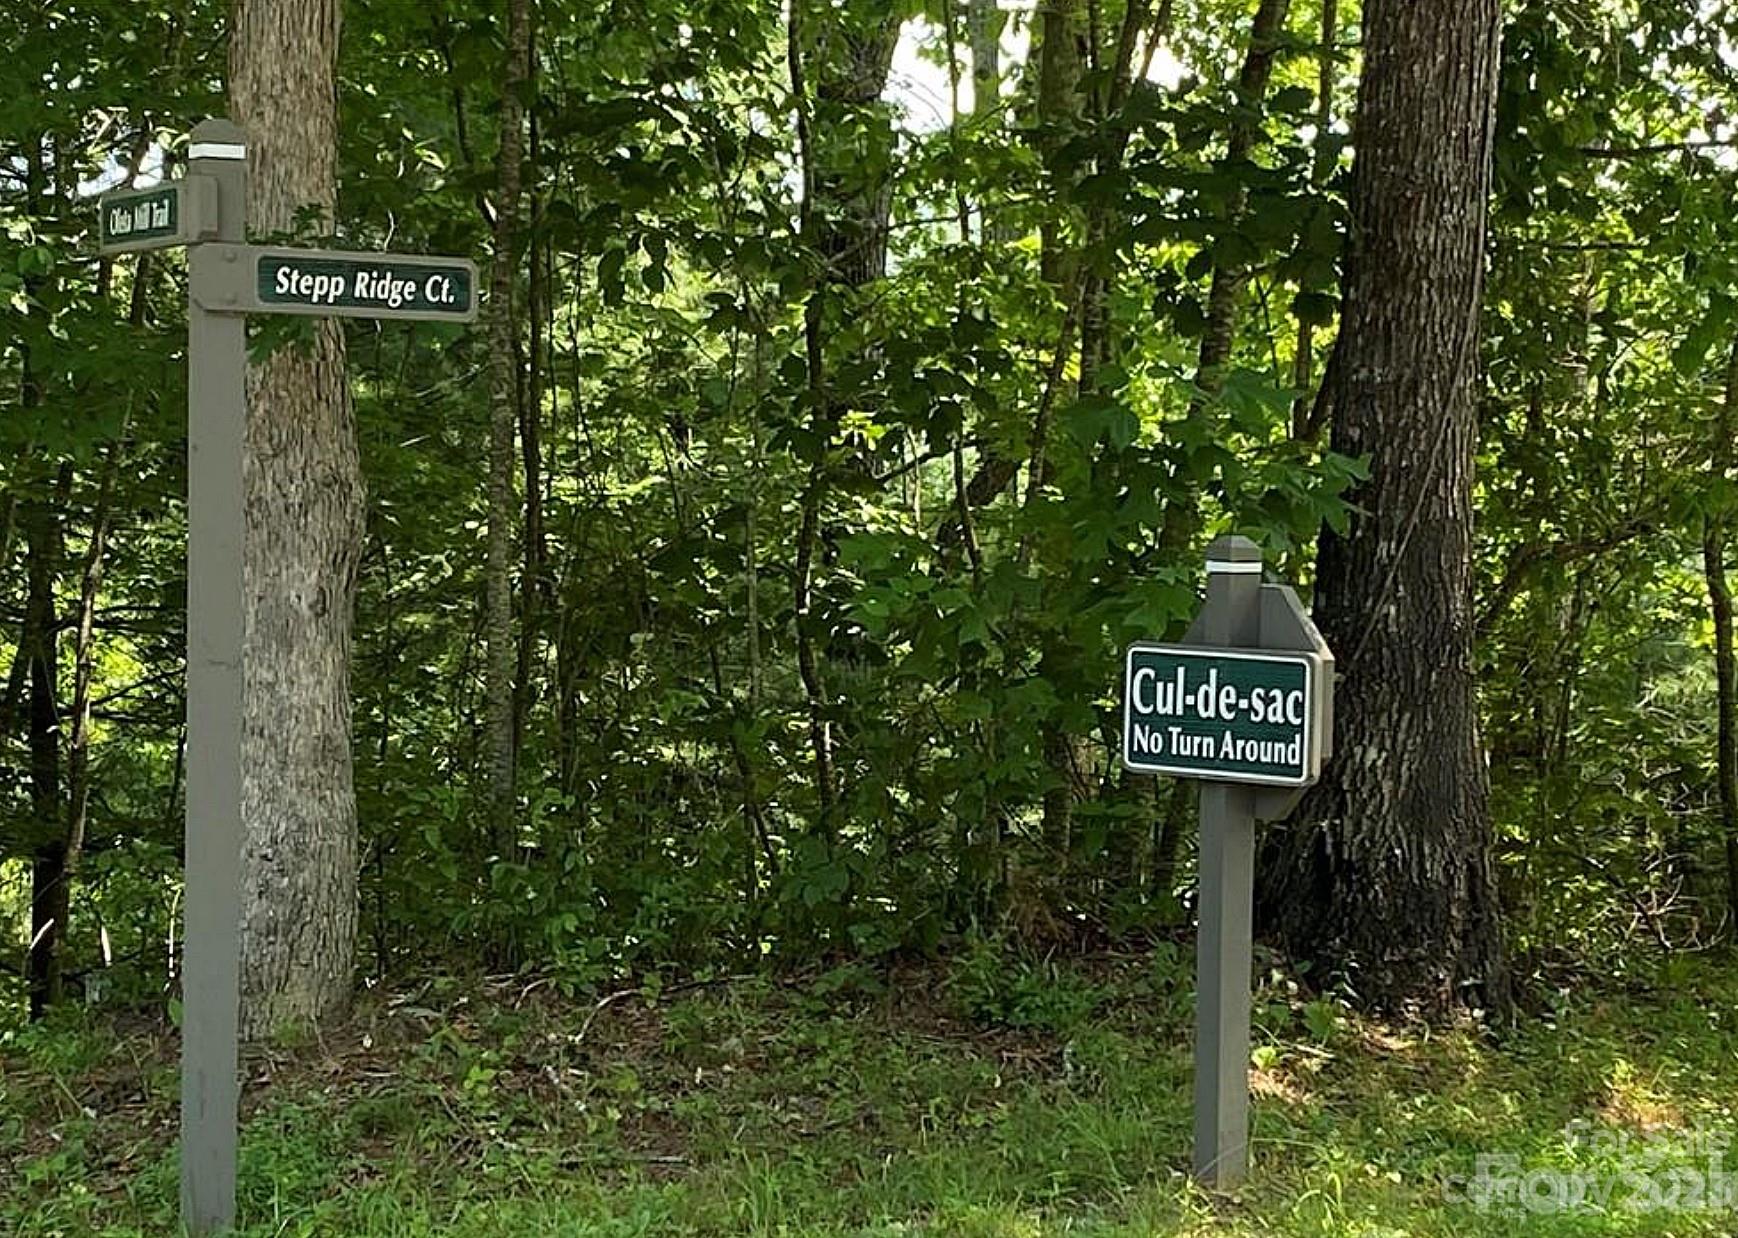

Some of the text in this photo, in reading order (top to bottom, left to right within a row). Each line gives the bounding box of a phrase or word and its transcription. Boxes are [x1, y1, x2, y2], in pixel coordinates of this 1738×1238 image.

[275, 266, 455, 308] Stepp Ridge Ct.
[1132, 666, 1304, 726] Cul-de-sac
[1133, 723, 1301, 766] No Turn Around
